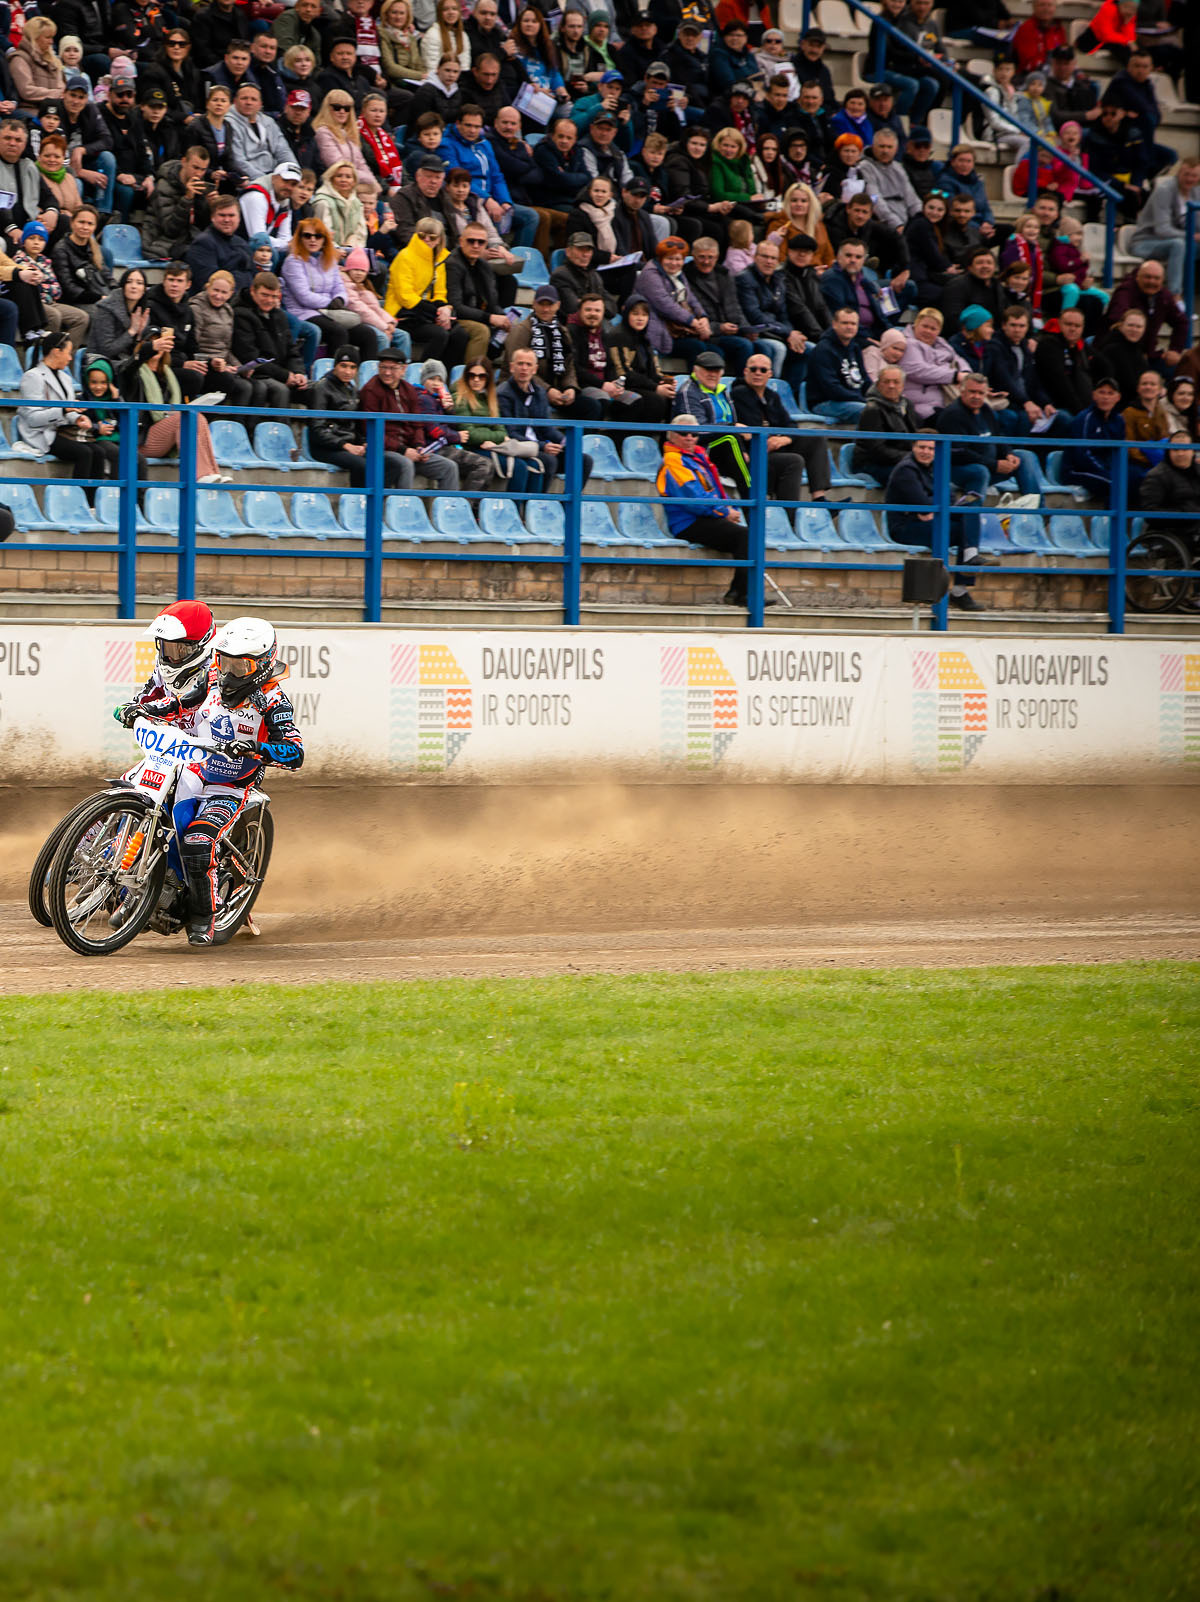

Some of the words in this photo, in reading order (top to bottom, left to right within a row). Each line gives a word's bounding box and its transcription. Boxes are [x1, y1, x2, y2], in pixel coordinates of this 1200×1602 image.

[482, 647, 604, 680] DAUGAVPILS
[747, 650, 862, 683] DAUGAVPILS
[996, 654, 1109, 686] DAUGAVPILS
[482, 694, 499, 726] IR
[505, 694, 572, 726] SPORTS
[747, 695, 762, 727] IS
[769, 695, 854, 727] SPEEDWAY
[996, 698, 1011, 729] IR
[1017, 698, 1078, 729] SPORTS
[142, 769, 165, 784] AMD
[149, 754, 174, 767] NEXORIS
[211, 759, 242, 770] NEXORIS
